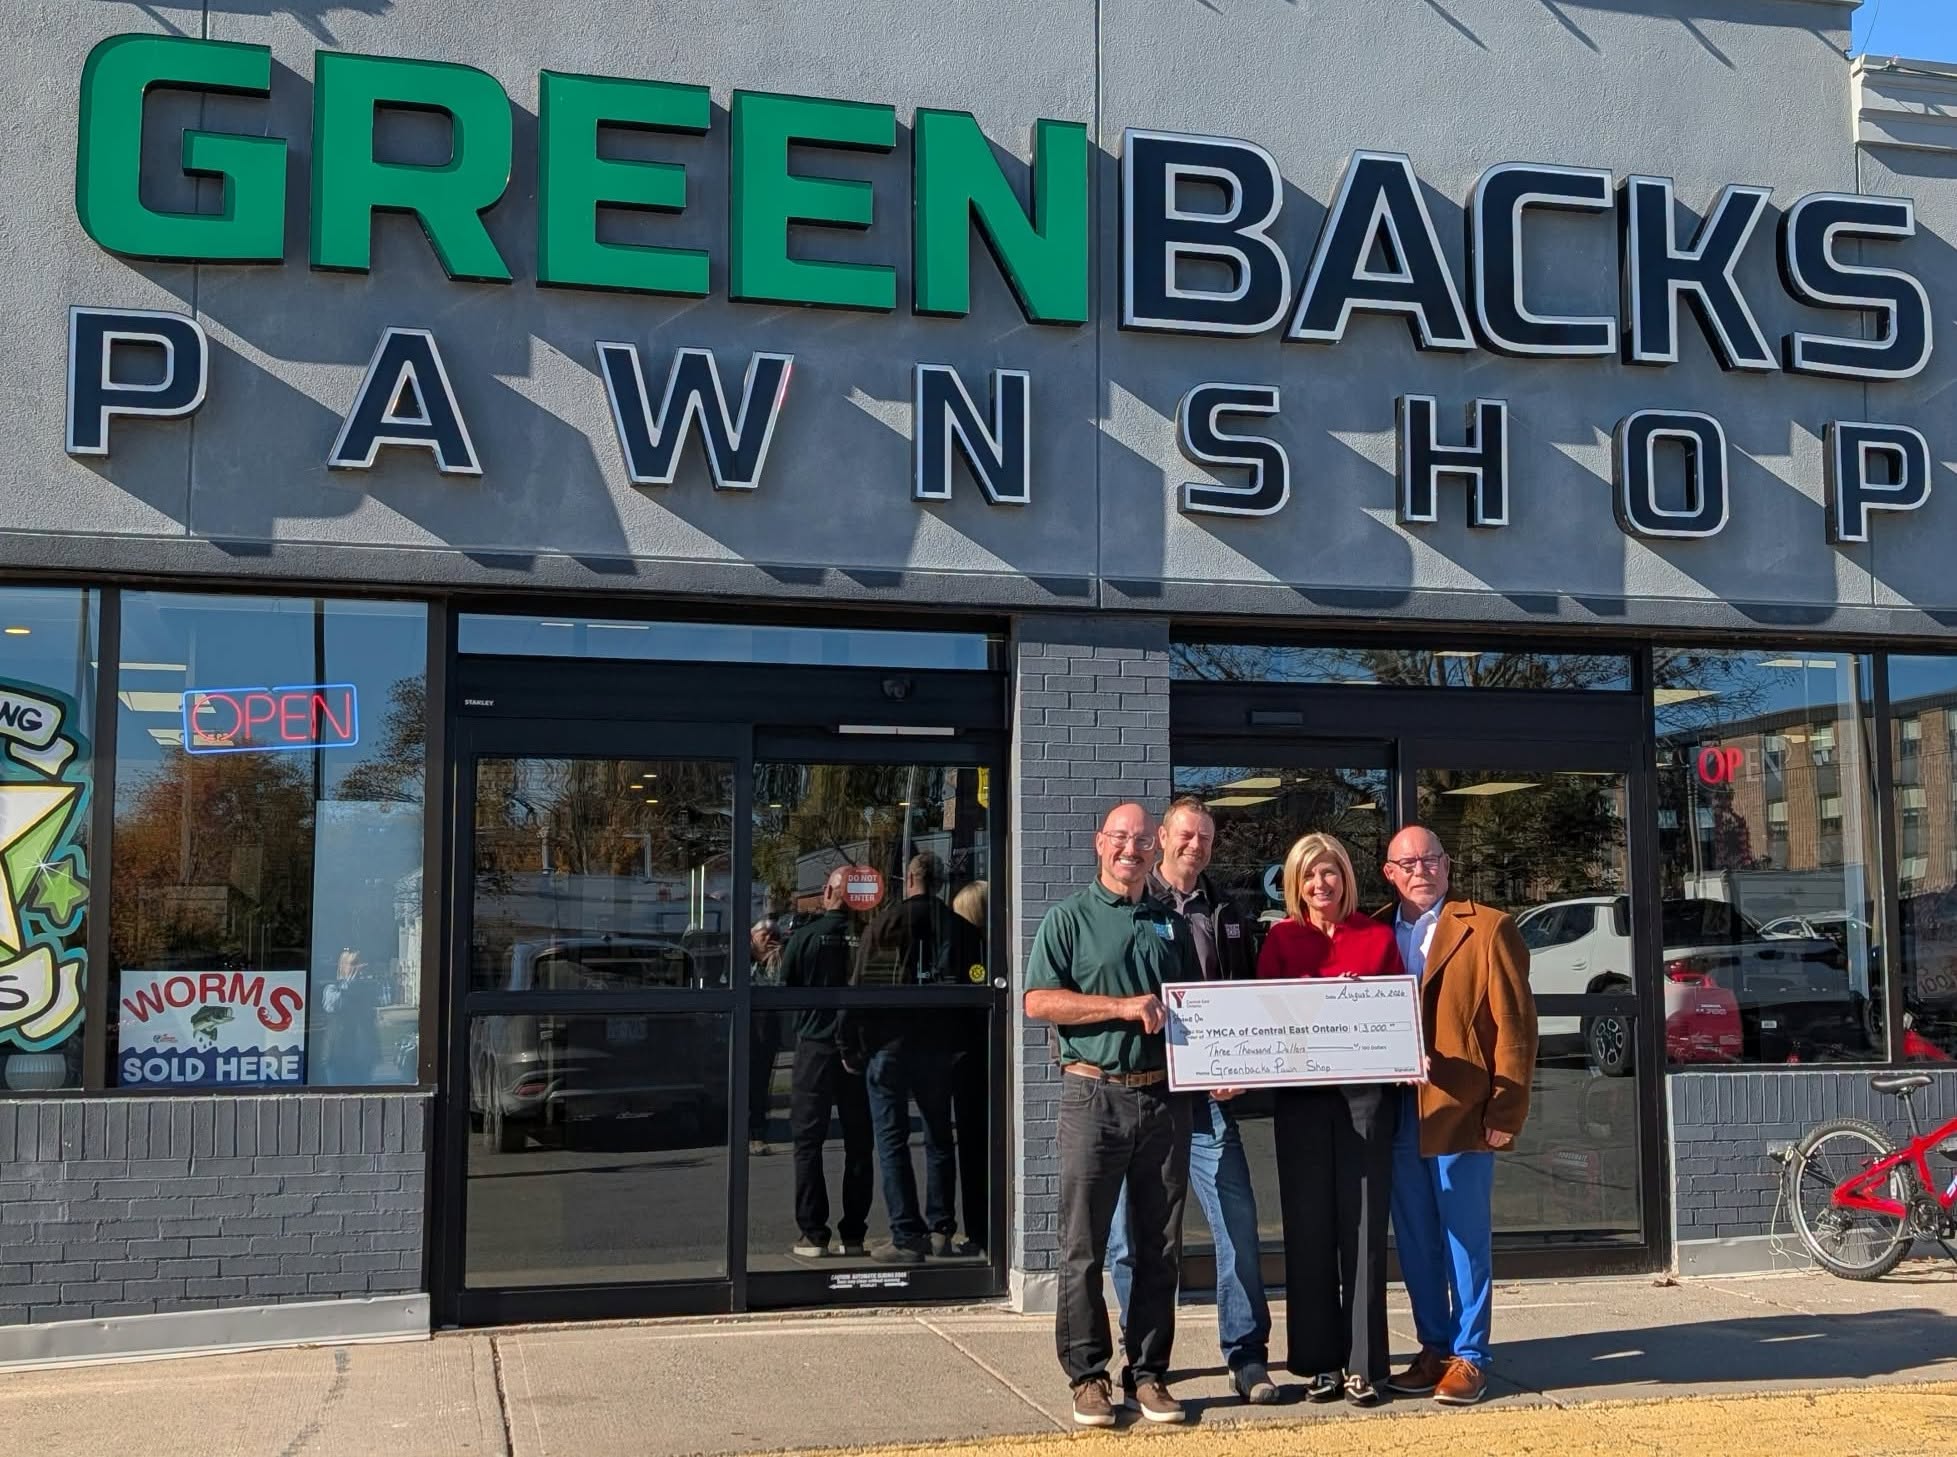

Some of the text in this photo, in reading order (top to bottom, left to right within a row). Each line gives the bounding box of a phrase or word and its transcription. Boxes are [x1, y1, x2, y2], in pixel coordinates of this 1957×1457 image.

[76, 33, 1934, 381] GREENBACKS
[65, 305, 1933, 545] PAWN SHOP
[192, 692, 350, 742] OPEN
[848, 874, 877, 882] DO NOT
[850, 894, 875, 902] ENTER
[122, 972, 304, 1032] WORMS
[1206, 1023, 1349, 1038] YMCA of Central East Ontario
[1204, 1040, 1306, 1057] Three Thousand Dollars
[123, 1055, 299, 1083] SOLD HERE
[1210, 1057, 1331, 1080] Greenbacks Pawn Shop
